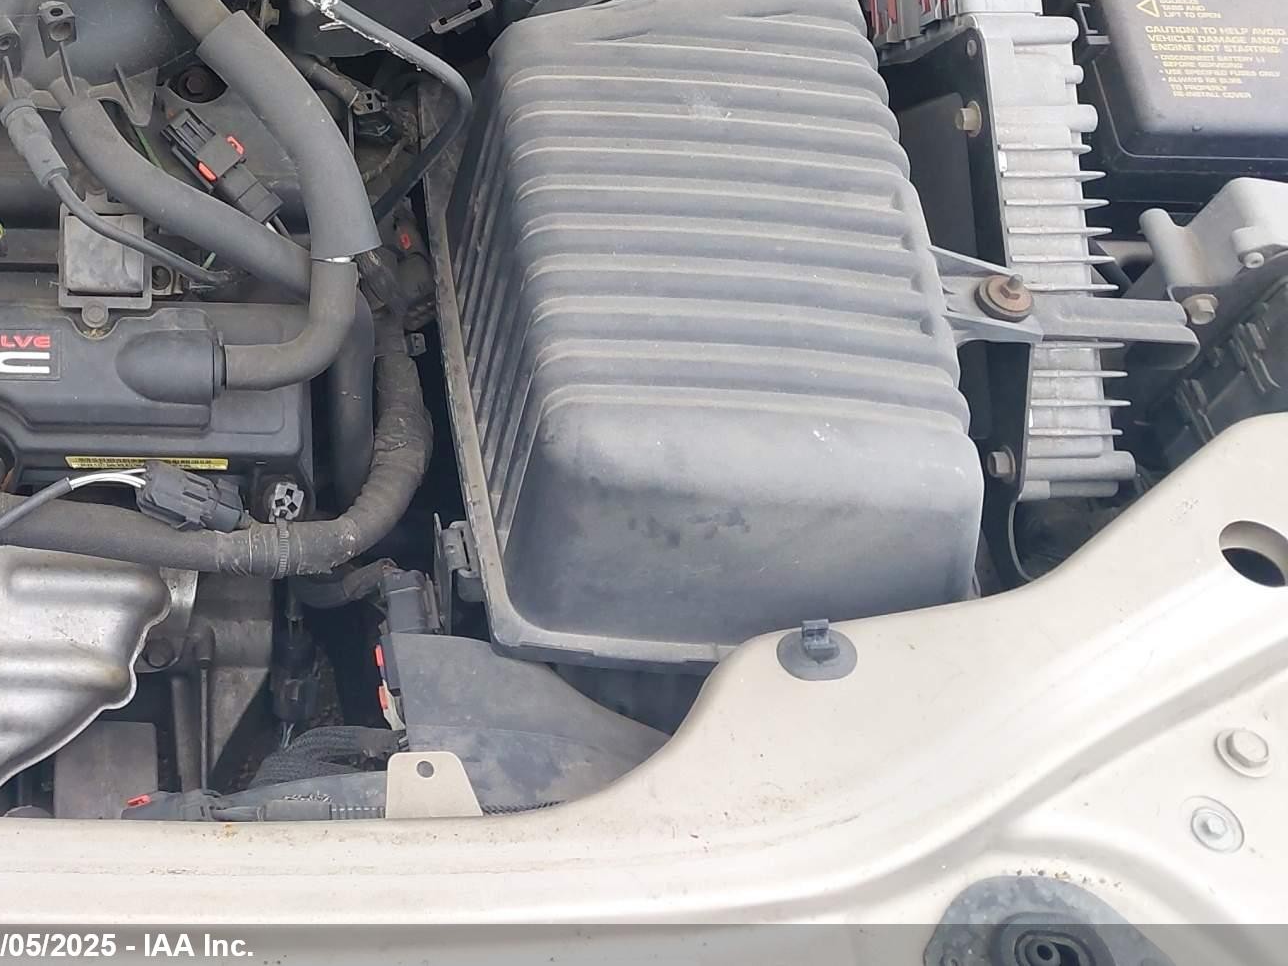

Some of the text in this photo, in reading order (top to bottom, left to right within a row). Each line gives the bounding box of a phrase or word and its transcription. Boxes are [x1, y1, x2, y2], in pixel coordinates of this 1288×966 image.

[1201, 26, 1218, 35] TO
[1219, 26, 1249, 36] HELP
[1252, 27, 1287, 37] AVOID
[1147, 34, 1196, 43] VEHICLE
[1198, 35, 1248, 44] DAMAGE
[1151, 43, 1194, 52] ENGINE
[1197, 44, 1221, 52] NOT
